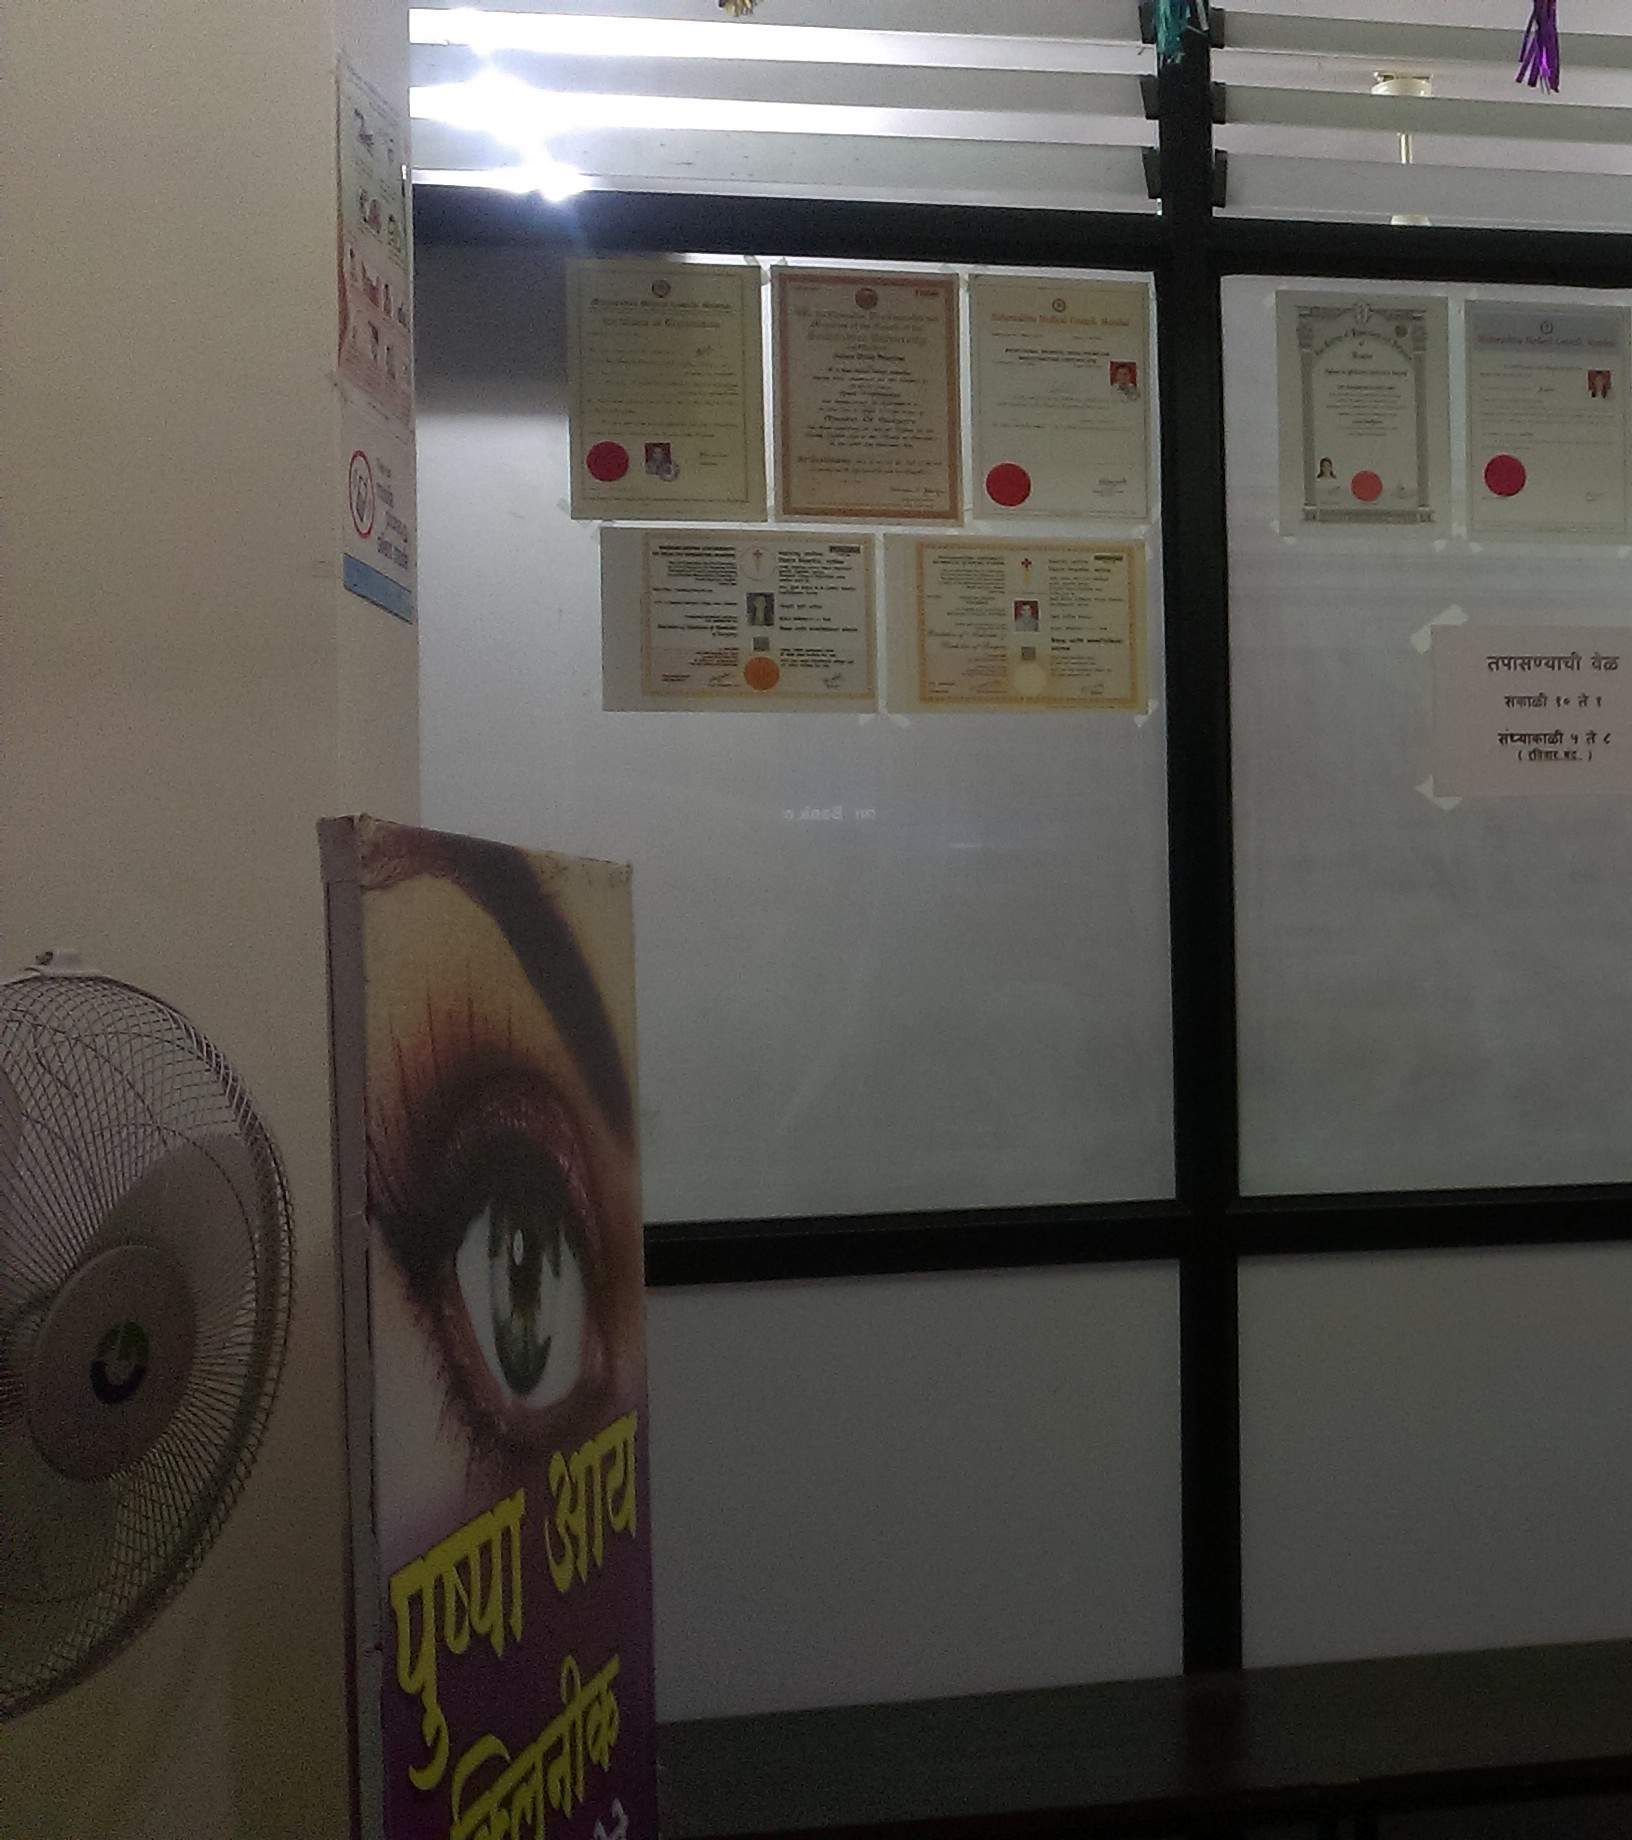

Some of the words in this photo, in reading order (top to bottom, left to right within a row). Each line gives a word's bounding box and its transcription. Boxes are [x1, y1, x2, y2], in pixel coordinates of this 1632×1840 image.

[1486, 651, 1582, 671] तपासण्याची
[1590, 651, 1620, 671] वेळ
[1504, 692, 1548, 708] सकाळी
[1577, 693, 1589, 708] ते
[1585, 729, 1598, 745] ते
[388, 1487, 526, 1790] पुष्पा
[544, 1410, 638, 1593] आय
